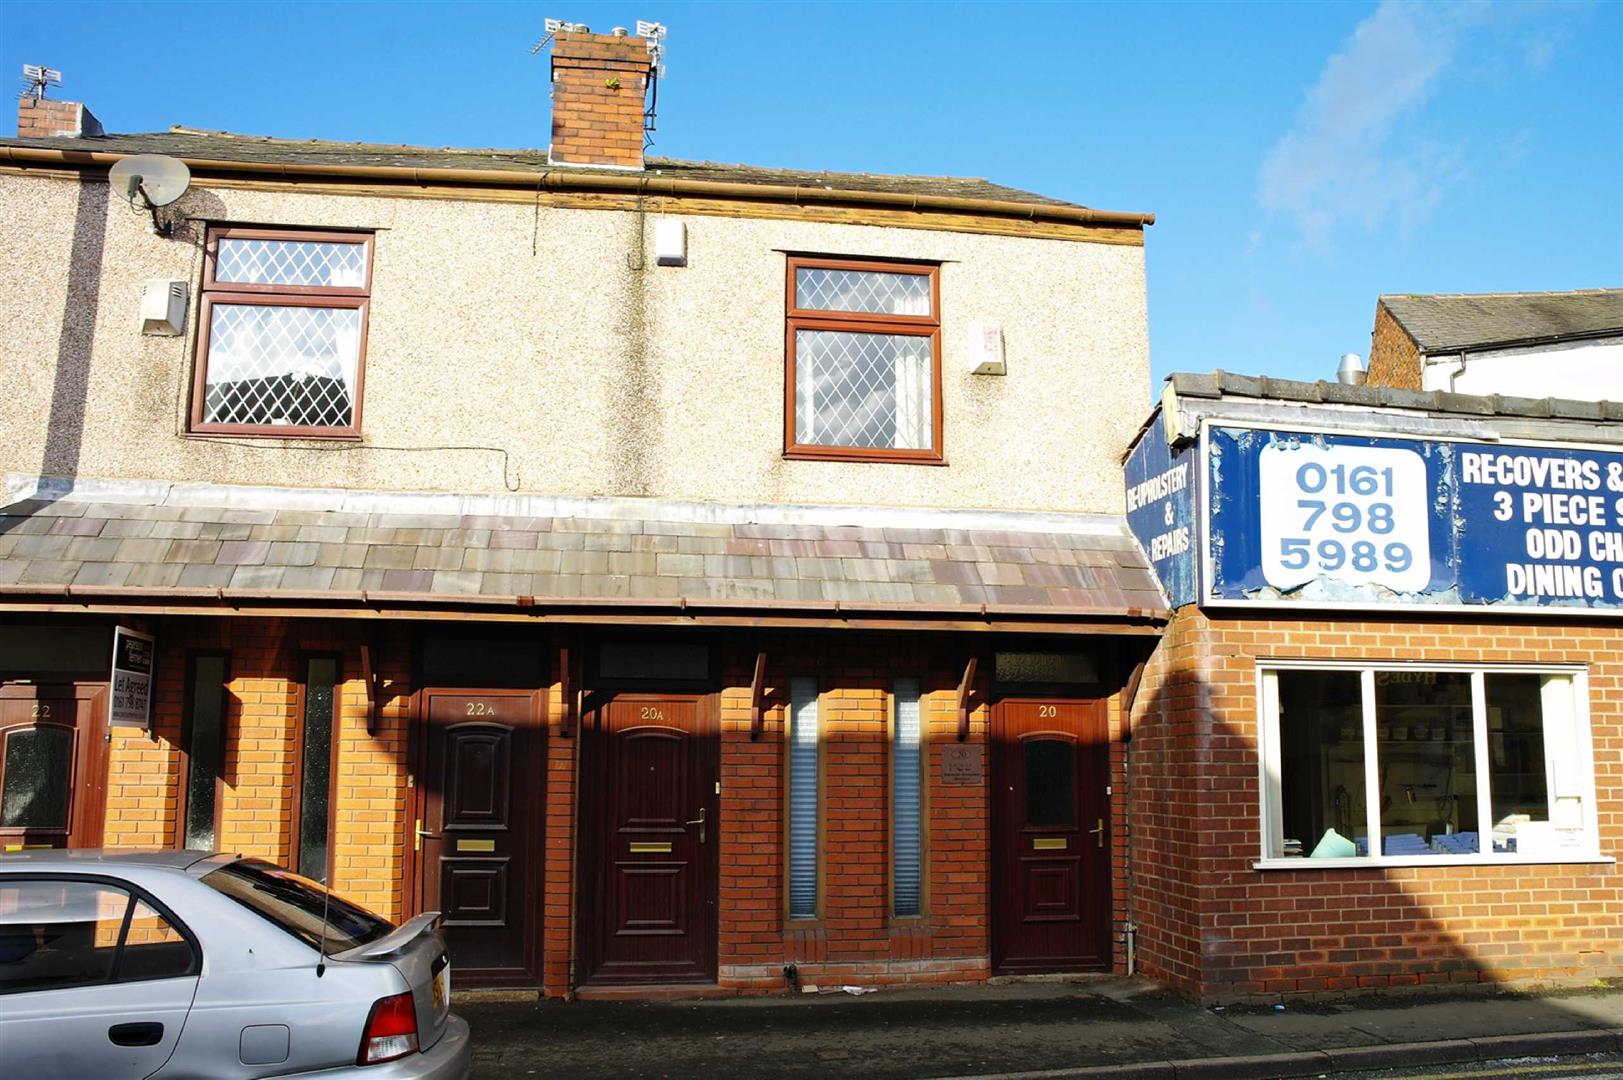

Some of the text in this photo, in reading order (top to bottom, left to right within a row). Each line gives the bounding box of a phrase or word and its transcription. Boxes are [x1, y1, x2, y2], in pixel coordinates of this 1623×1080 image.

[1127, 462, 1189, 514] RE-UPHOLSTERY
[1296, 462, 1393, 497] 0161
[1461, 452, 1623, 493] RECOVERS &
[1164, 501, 1174, 526] &
[1297, 499, 1395, 535] 798
[1493, 490, 1513, 522] 3
[1523, 492, 1606, 526] PIECE
[1151, 526, 1189, 562] REPAIRS
[1280, 538, 1413, 573] 5989
[1526, 527, 1582, 560] ODD
[1506, 563, 1604, 598] DINING
[114, 675, 149, 698] Let Agreed
[31, 704, 51, 718] 22
[466, 702, 496, 716] 22A
[641, 706, 664, 721] 20A
[1039, 705, 1057, 718] 20
